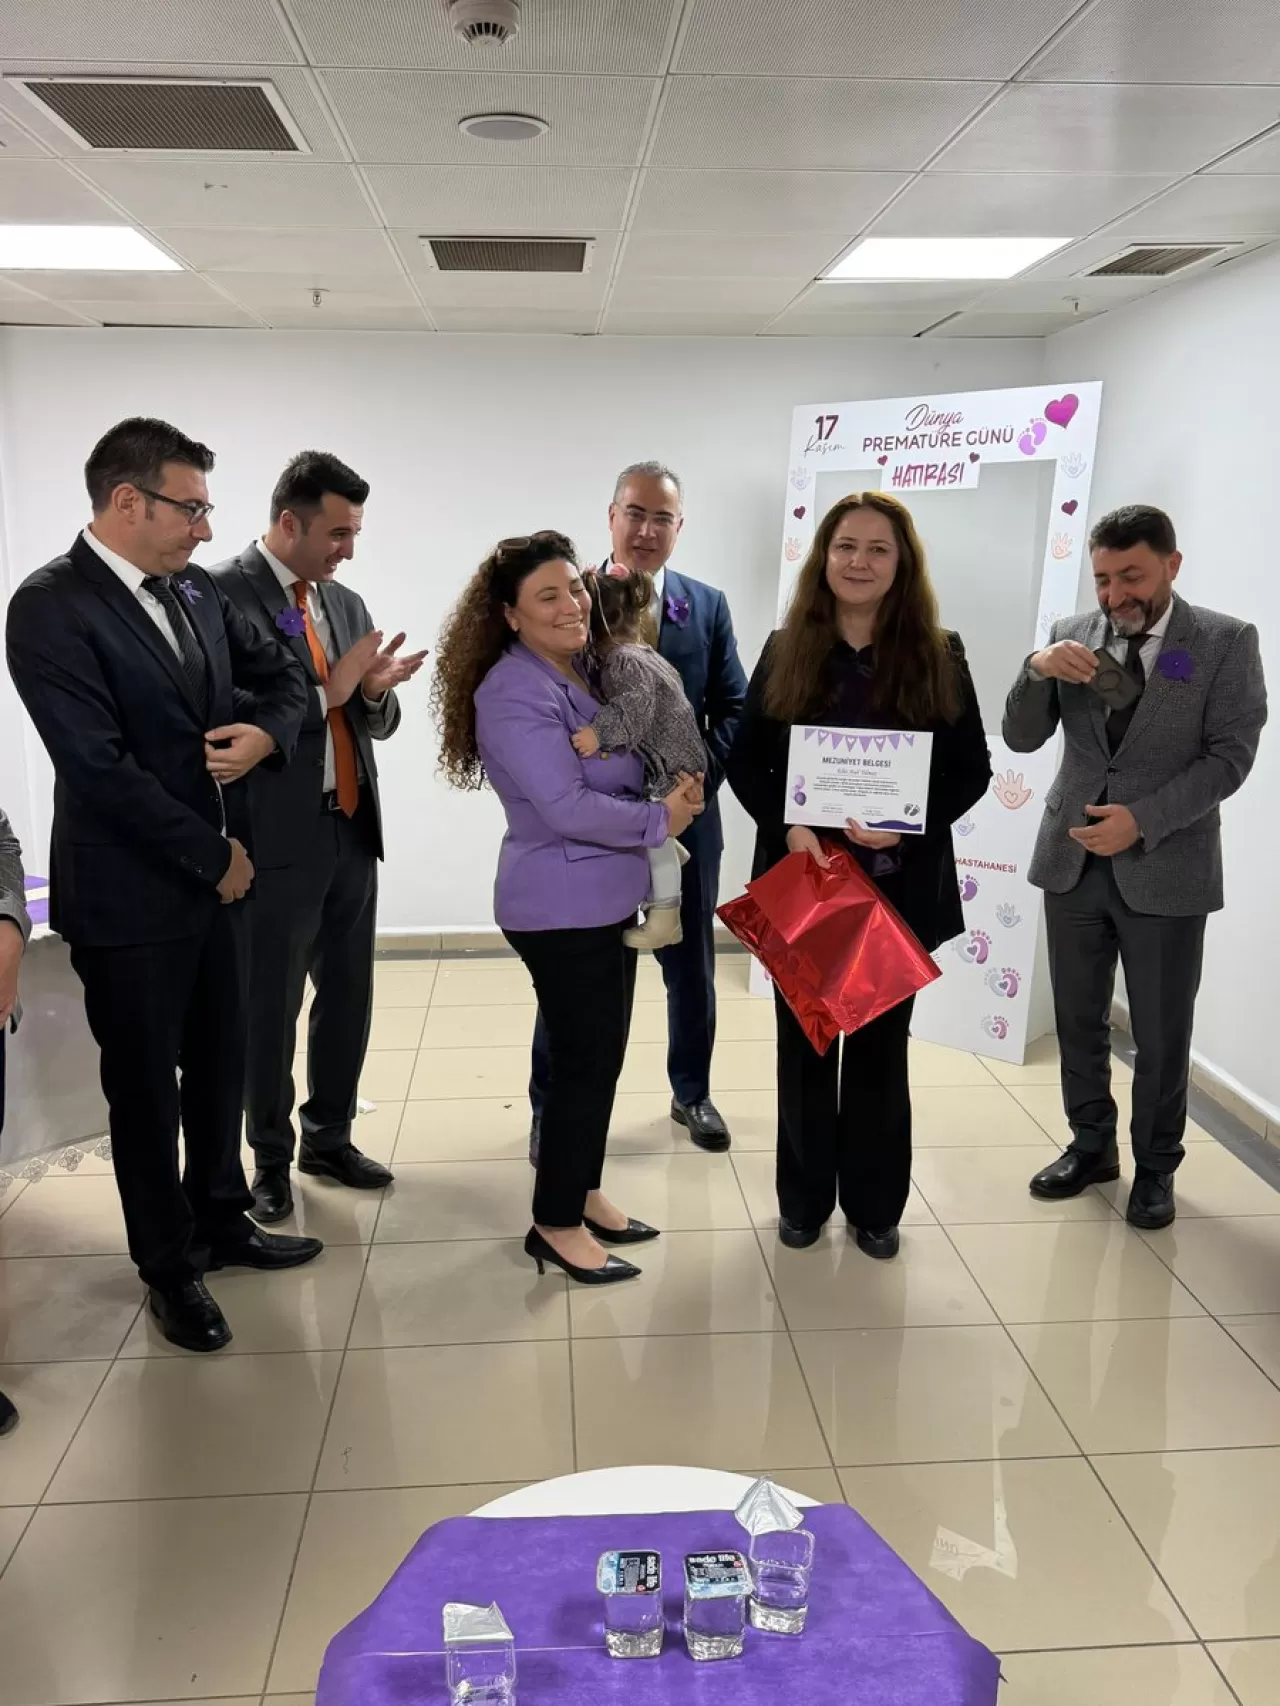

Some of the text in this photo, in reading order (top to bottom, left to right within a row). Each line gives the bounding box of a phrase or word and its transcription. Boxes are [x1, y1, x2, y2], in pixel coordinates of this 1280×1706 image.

[815, 415, 839, 440] 17
[904, 403, 963, 434] Dünya
[966, 425, 1014, 446] GÜNÜ
[892, 461, 965, 488] HATIRASI
